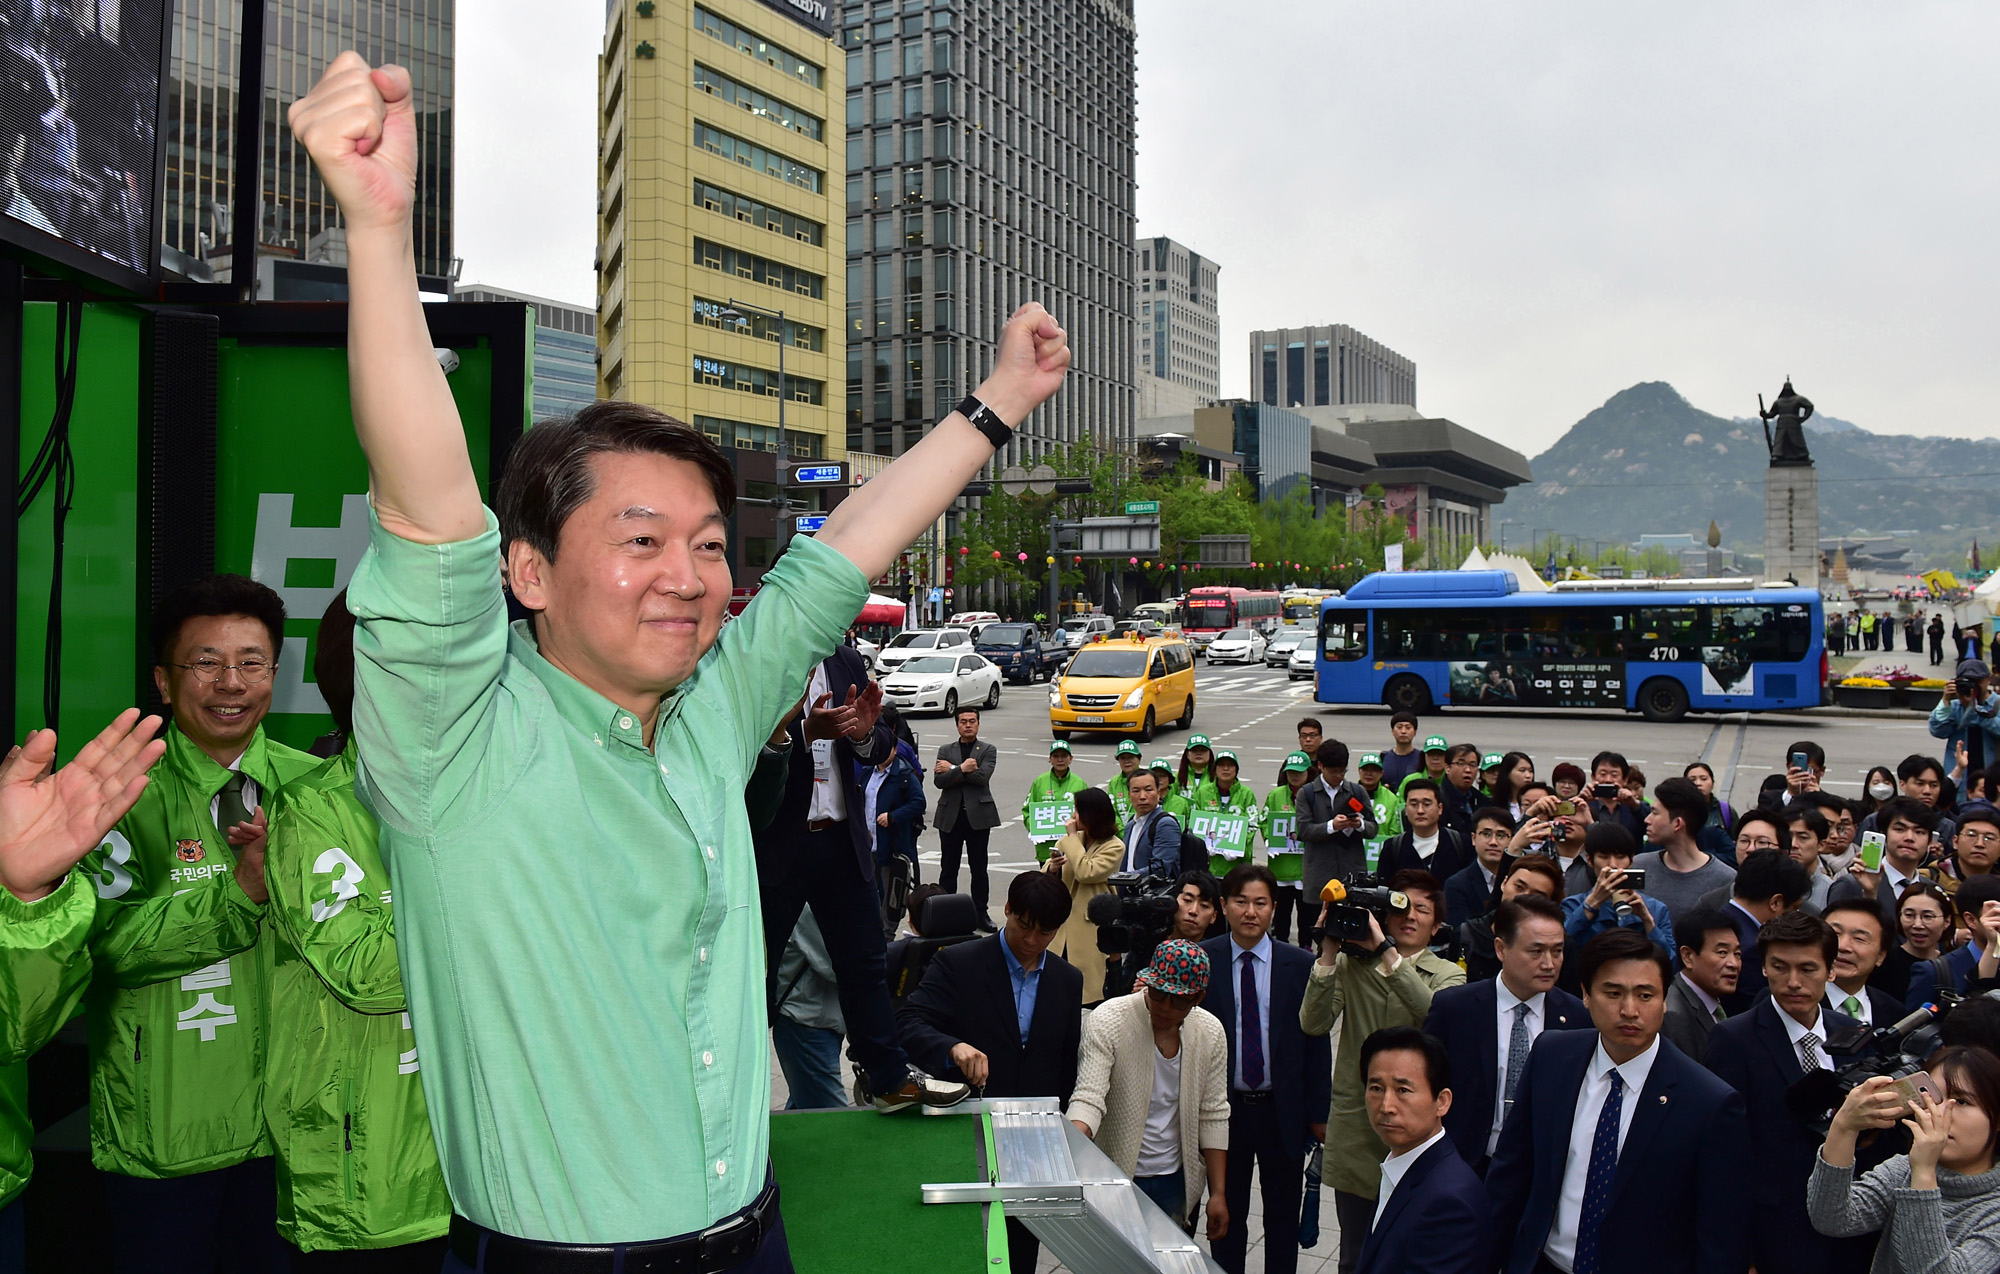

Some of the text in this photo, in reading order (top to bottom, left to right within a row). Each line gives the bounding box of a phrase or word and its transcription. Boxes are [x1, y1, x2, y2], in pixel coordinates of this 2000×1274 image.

[813, 1, 826, 20] TV
[1649, 646, 1679, 661] 470
[1374, 803, 1387, 825] 3
[1192, 816, 1244, 845] 미래
[95, 830, 133, 899] 3
[312, 847, 365, 923] 3
